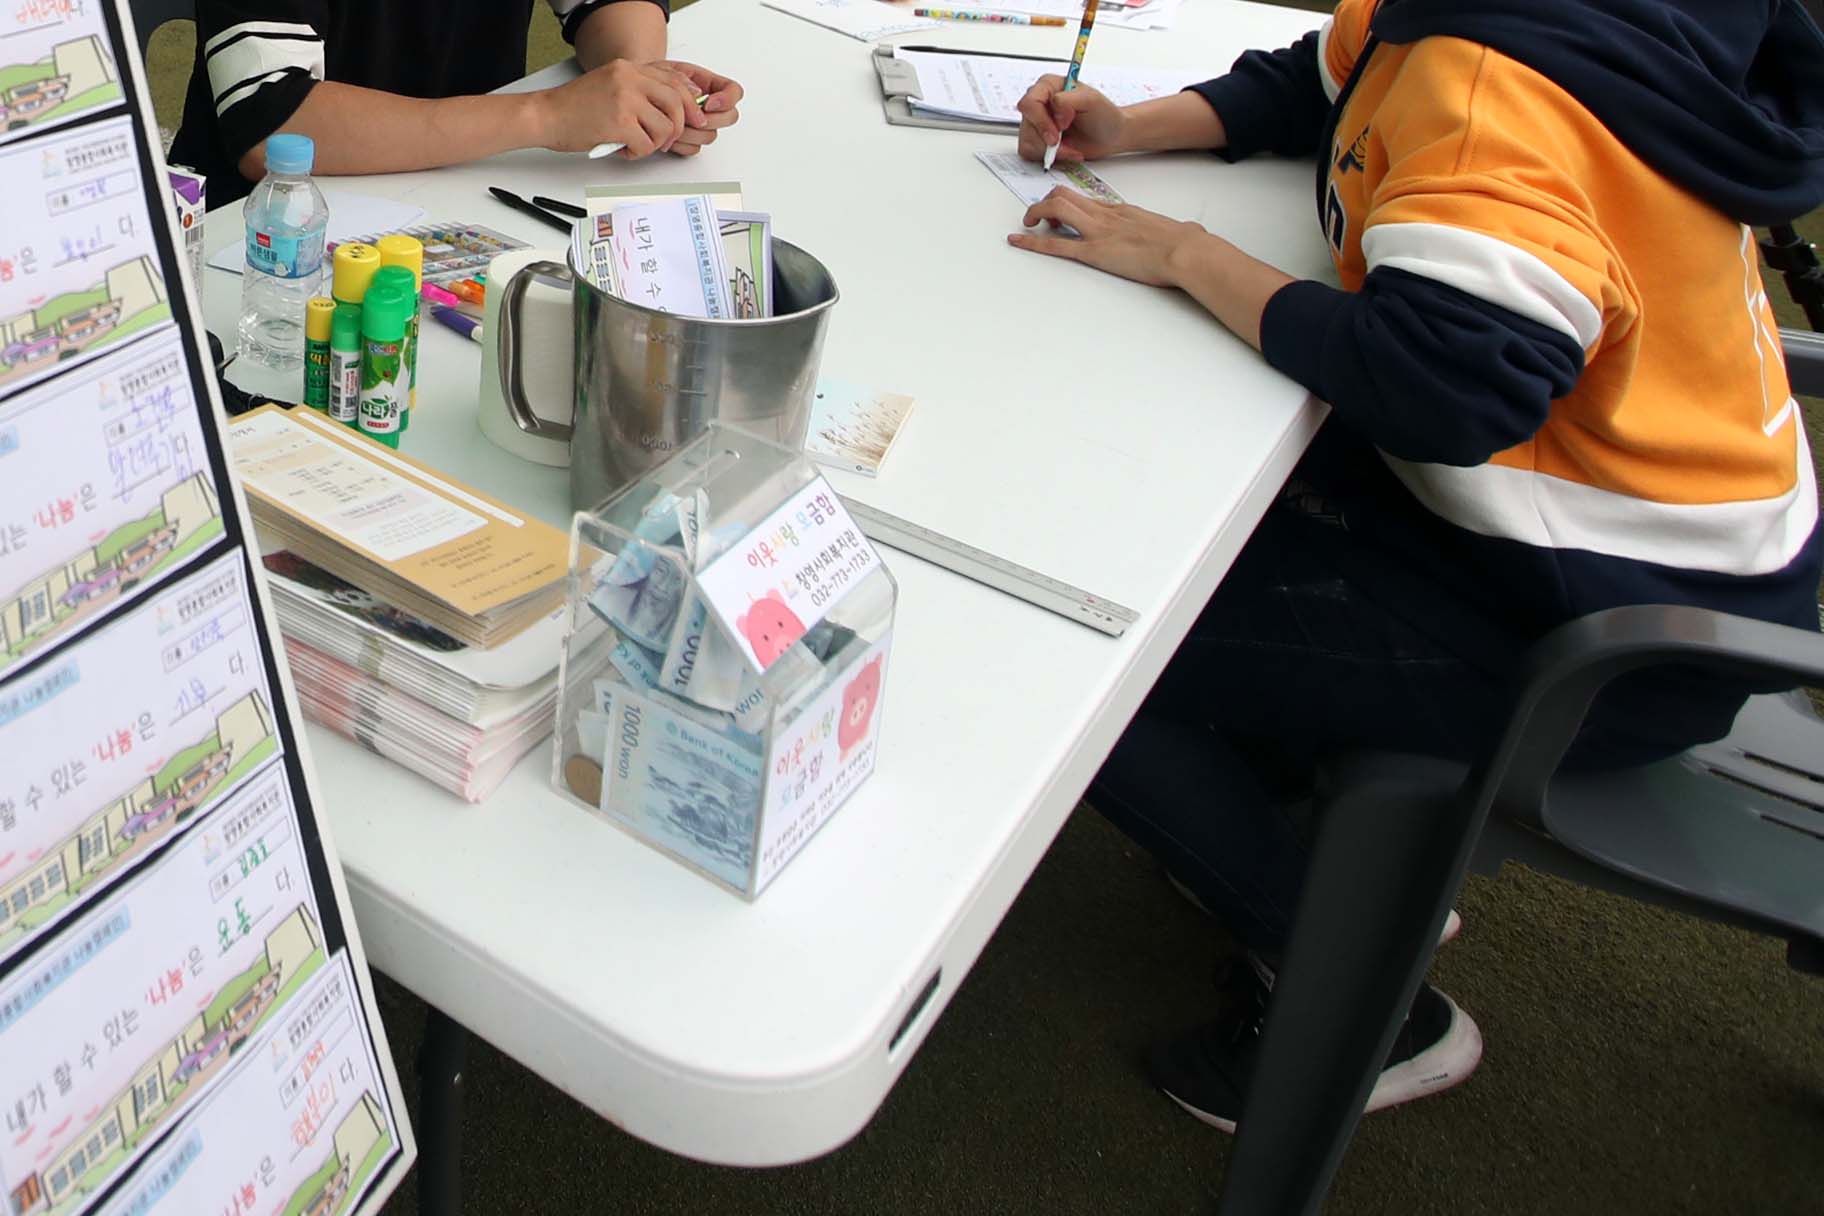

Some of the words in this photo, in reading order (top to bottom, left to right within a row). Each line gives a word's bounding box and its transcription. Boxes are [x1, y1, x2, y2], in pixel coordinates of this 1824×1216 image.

[635, 217, 654, 251] 내가
[641, 258, 659, 274] 할
[646, 281, 662, 298] 수
[746, 522, 800, 570] 이웃사랑
[797, 493, 836, 532] 모금함
[798, 529, 859, 592] 창영사회복지관
[811, 549, 871, 608] 032-773-1733
[620, 702, 641, 748] 1000
[618, 749, 631, 780] won
[6, 1084, 46, 1132] 내가
[53, 1062, 72, 1096] 할
[81, 1043, 97, 1070] 수
[103, 1009, 139, 1051] 있는
